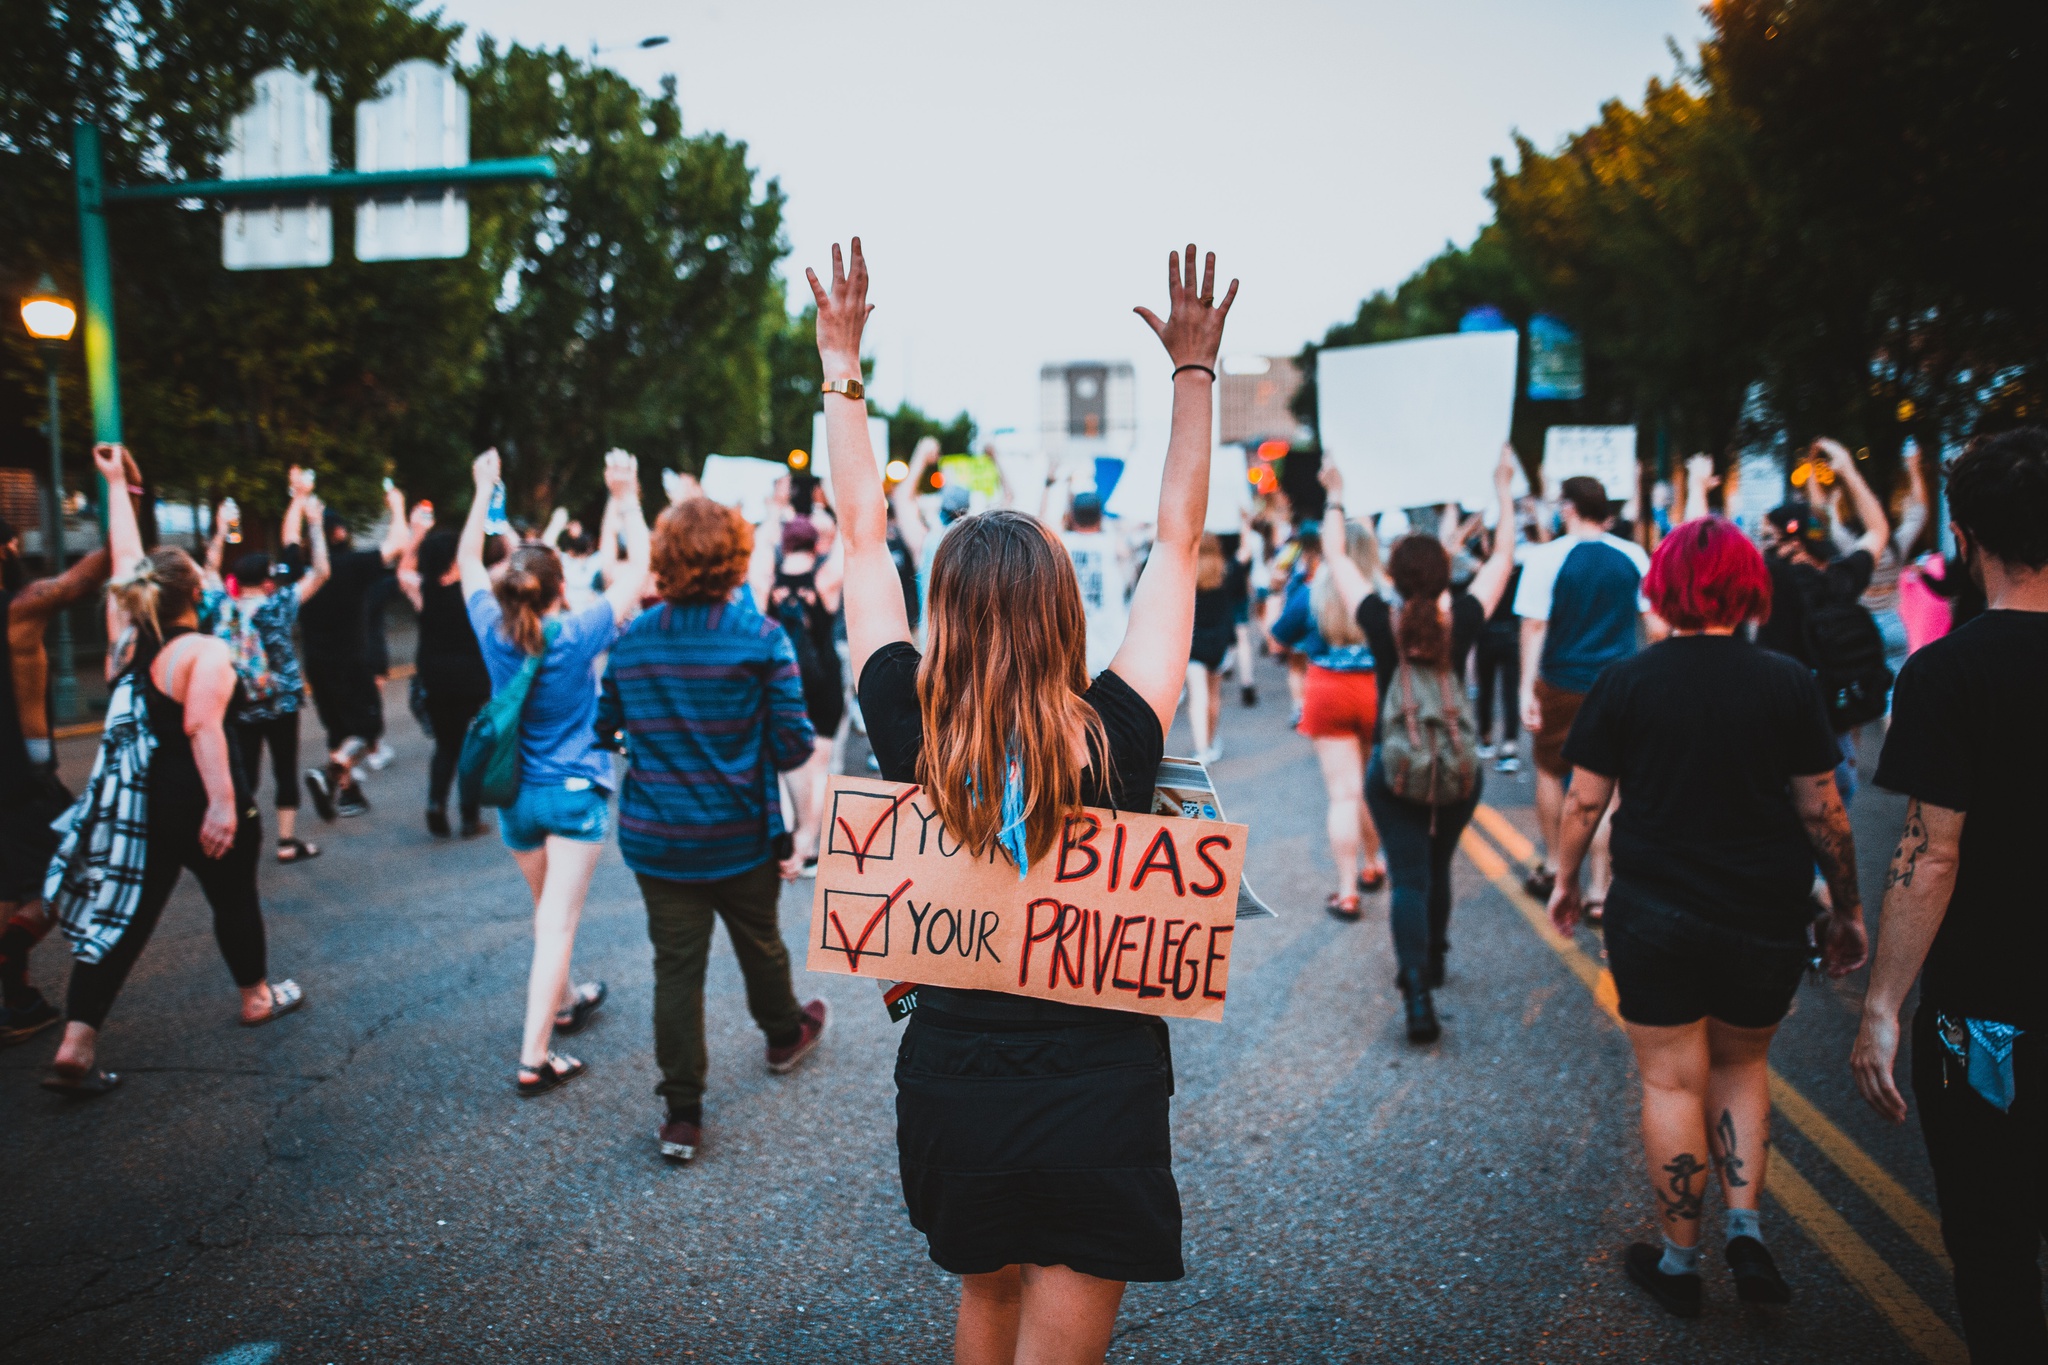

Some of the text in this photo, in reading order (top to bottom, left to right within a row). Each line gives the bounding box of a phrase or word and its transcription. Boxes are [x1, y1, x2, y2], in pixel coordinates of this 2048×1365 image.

[1055, 813, 1232, 897] BIAS
[906, 897, 1235, 1001] YOUR PRIVELEGE
